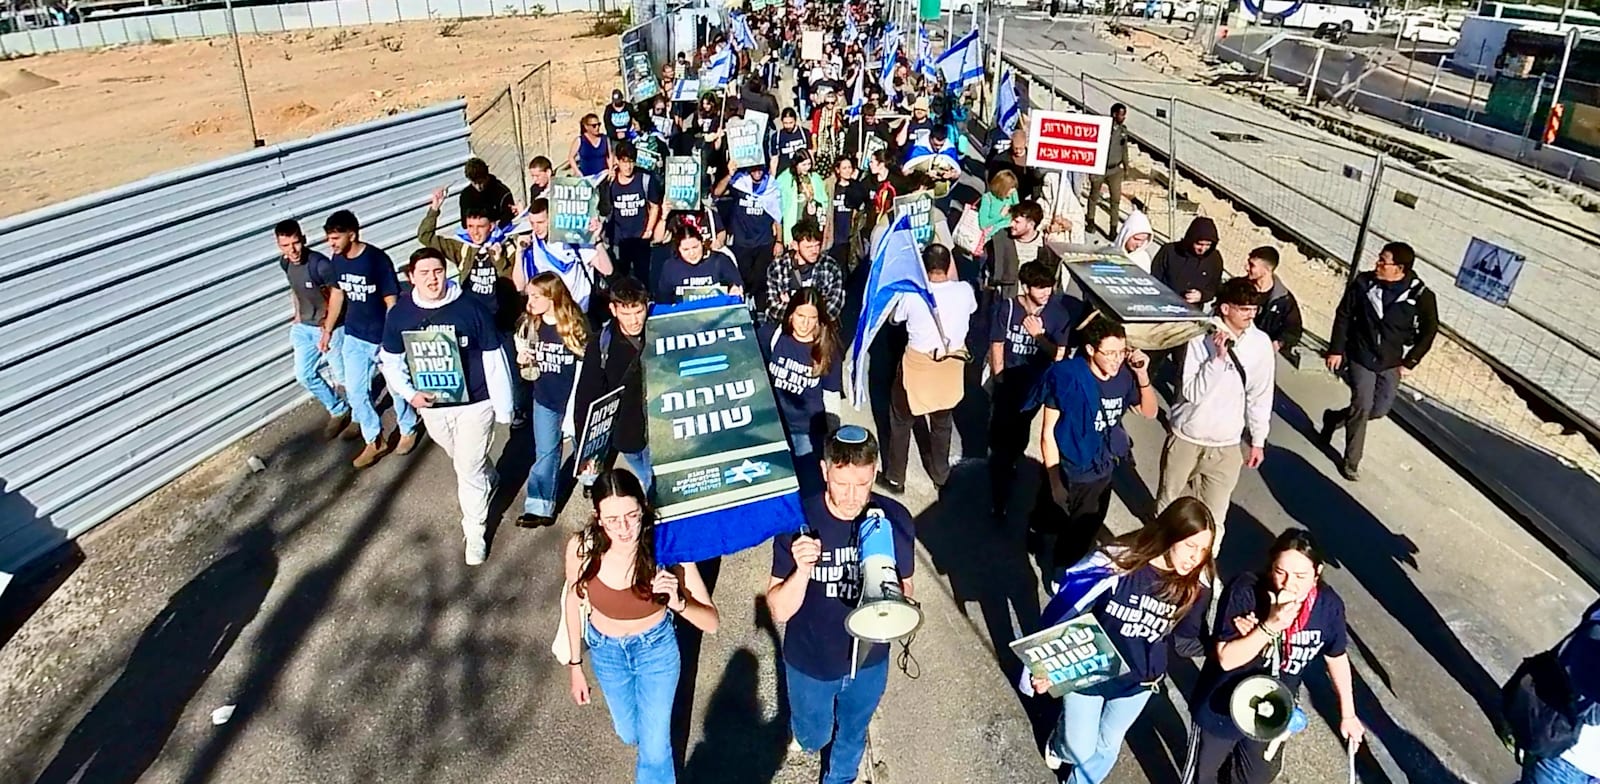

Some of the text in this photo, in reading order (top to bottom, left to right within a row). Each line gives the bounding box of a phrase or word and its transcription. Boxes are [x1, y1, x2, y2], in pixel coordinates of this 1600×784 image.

[669, 162, 698, 175] שירות
[554, 184, 592, 201] שירות
[669, 187, 696, 202] לכולם
[557, 200, 588, 215] שווה
[554, 213, 590, 231] לכולם
[910, 212, 930, 228] שוו
[1089, 275, 1155, 286] שירות
[1105, 285, 1161, 296] שווה
[410, 341, 452, 357] רוצים
[655, 326, 746, 355] ביטחון
[413, 356, 454, 373] לשרת
[419, 373, 458, 388] בכבוד
[774, 377, 805, 396] לכולם
[660, 379, 756, 413] שירות
[590, 398, 620, 427] שירות
[589, 415, 614, 442] שווה
[672, 405, 753, 440] שווה
[1104, 599, 1143, 623] שווה
[1119, 622, 1161, 644] לכולם
[1024, 627, 1096, 663] שירות
[1041, 642, 1098, 672] שווה
[1047, 653, 1109, 685] לכולם
